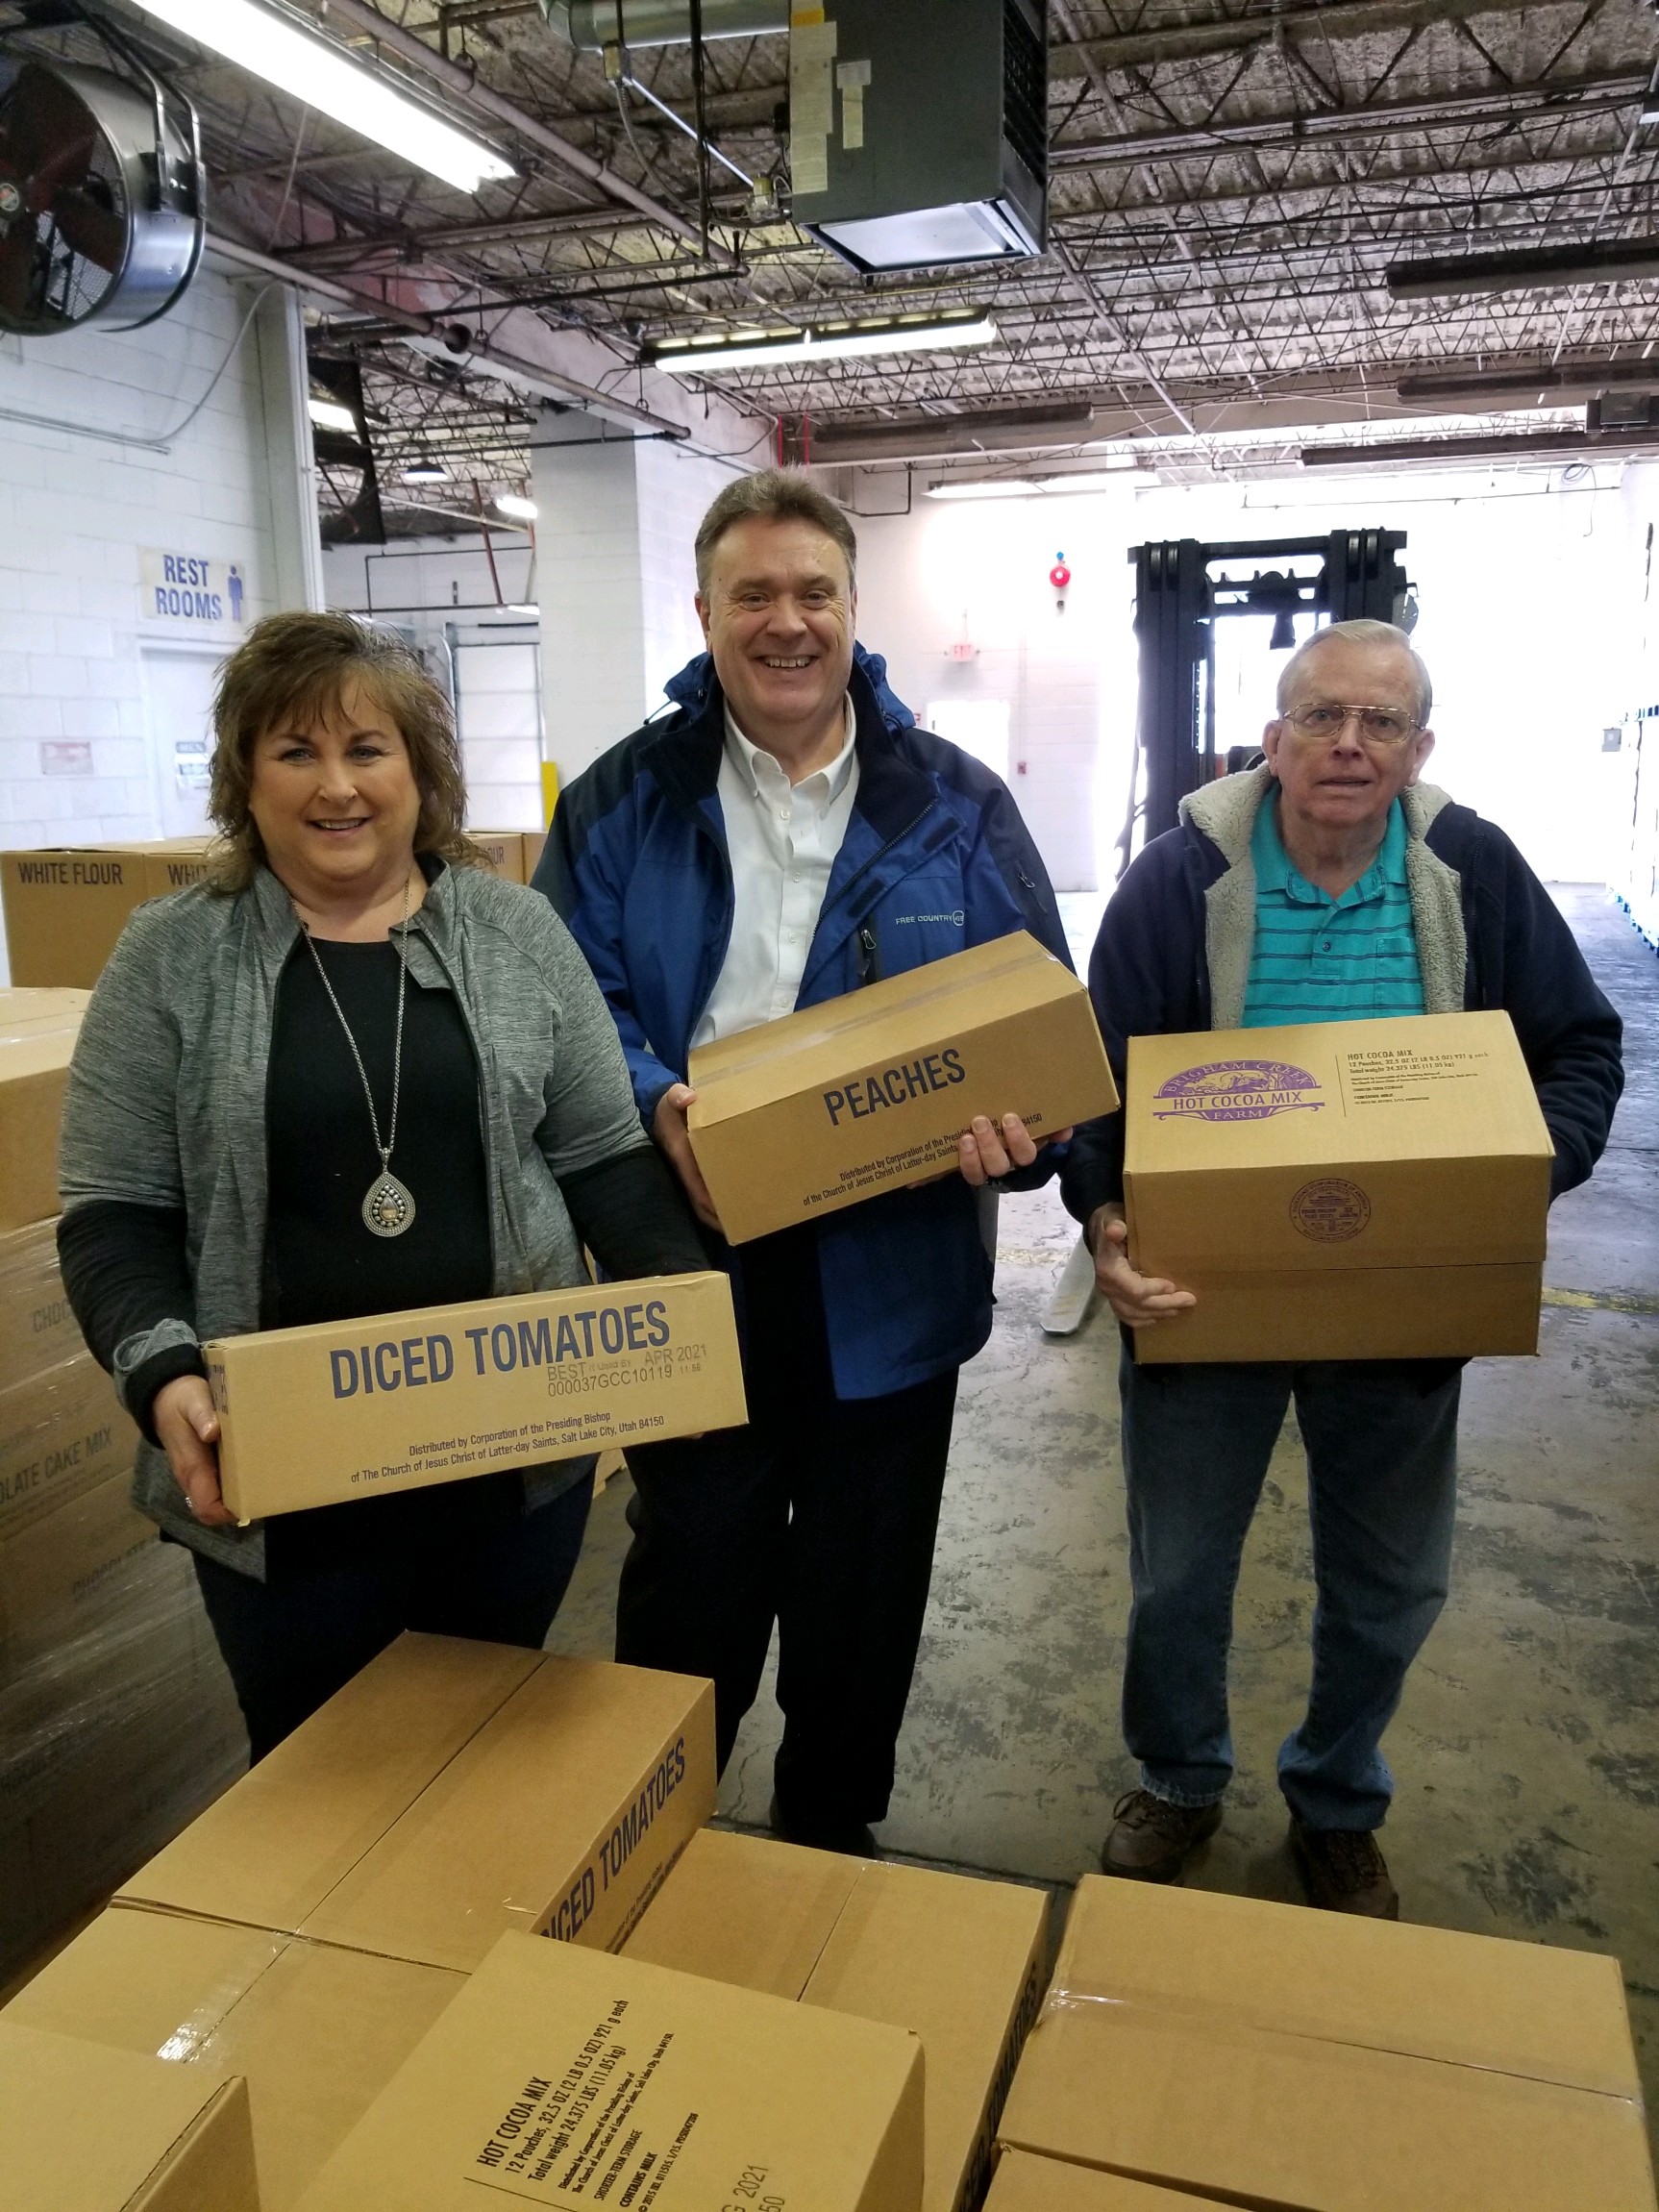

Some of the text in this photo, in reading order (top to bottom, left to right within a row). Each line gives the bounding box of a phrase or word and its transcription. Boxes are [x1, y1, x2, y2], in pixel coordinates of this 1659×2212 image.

[162, 554, 209, 587] REST
[155, 586, 222, 620] ROOMS
[17, 862, 124, 885] WHITE FLOUR
[895, 916, 916, 926] FREE
[917, 914, 953, 923] COUNTRY
[823, 1048, 966, 1126] PEACHES
[1164, 1061, 1310, 1092] BRIGHAM CREEK
[1174, 1091, 1302, 1109] HOT COCOA MIX
[1213, 1109, 1264, 1120] FARM
[839, 1162, 877, 1181] Distributed
[876, 1158, 885, 1170] by
[885, 1145, 924, 1164] Corporation
[925, 1140, 932, 1151] of
[931, 1137, 943, 1149] the
[804, 1197, 810, 1205] of
[810, 1192, 823, 1204] the
[822, 1183, 847, 1199] Church
[847, 1181, 854, 1191] of
[855, 1174, 875, 1187] Jesus
[875, 1166, 895, 1180] Christ
[895, 1162, 903, 1173] of
[903, 1152, 936, 1170] Latter-day
[330, 1300, 670, 1399] DICED TOMATOES
[547, 1362, 586, 1381] BEST
[645, 1348, 674, 1366] APR
[677, 1343, 706, 1362] 2021
[548, 1364, 673, 1397] 000037GCC10119
[351, 1415, 664, 1482] of The Church of Jesus Christ of Latter-day Saints, Salt Lake City, Utah 84150
[409, 1412, 611, 1456] Distributed by Corporation of the Presiding Bishop
[44, 1440, 82, 1479] CAKE
[86, 1426, 112, 1457] MIX
[599, 1736, 685, 1892] TOMATOES
[611, 2000, 630, 2017] each
[583, 2039, 605, 2053] OZ)
[593, 2024, 613, 2038] 921
[566, 2069, 583, 2079] LB
[574, 2053, 593, 2068] 0.5
[552, 2090, 571, 2103] OZ
[559, 2079, 577, 2091] (2
[476, 2075, 553, 2167] HOT COCOA MIX
[527, 2045, 627, 2181] Total weight 24.375 LBS (11.05 kg)
[538, 2103, 561, 2124] 32.5
[513, 2126, 552, 2160] Pouches,
[505, 2160, 525, 2174] 12
[593, 2128, 642, 2201] SHORTER-TERM STORAGE
[619, 2151, 658, 2208] CONTAINS MILK
[732, 2165, 769, 2199] 2021
